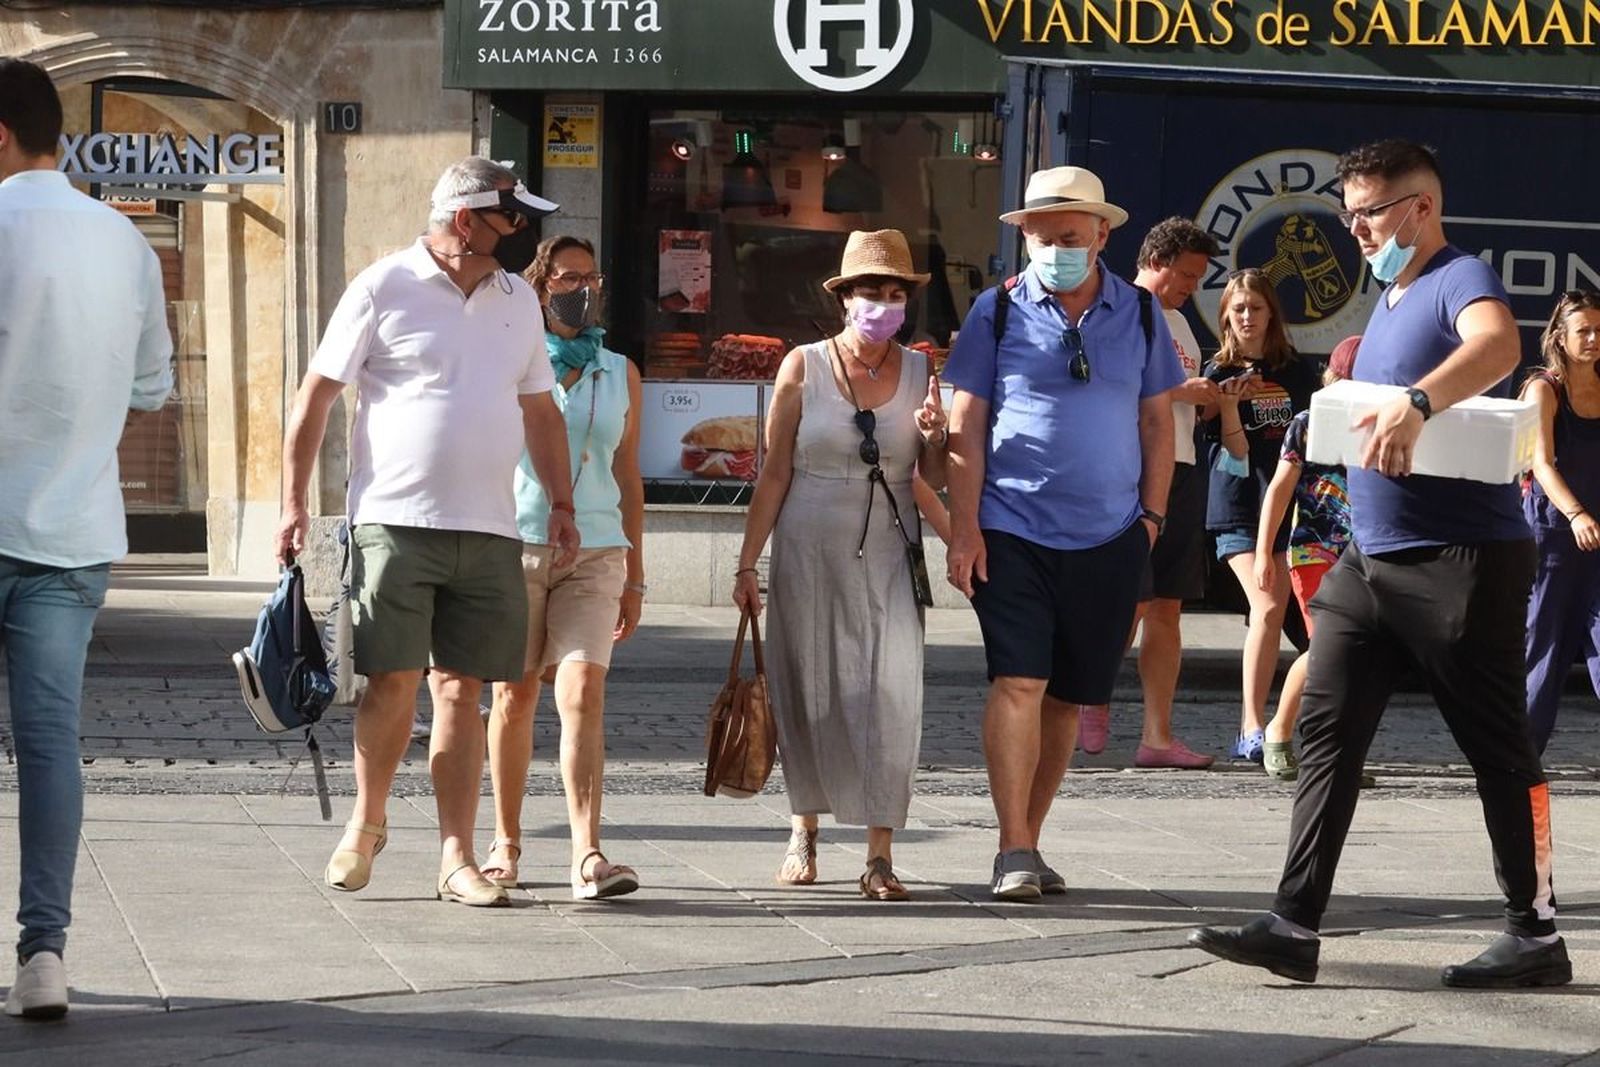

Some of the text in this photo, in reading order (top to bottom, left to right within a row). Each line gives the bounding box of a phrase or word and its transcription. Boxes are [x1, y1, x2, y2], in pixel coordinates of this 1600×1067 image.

[973, 0, 1234, 46] VIANDAS
[1256, 0, 1311, 47] de
[477, 47, 664, 64] SALAMANCA 1366
[328, 103, 357, 132] 10
[57, 132, 281, 174] XCHANGE
[547, 144, 594, 153] PROSEGUR
[1480, 248, 1600, 296] ON
